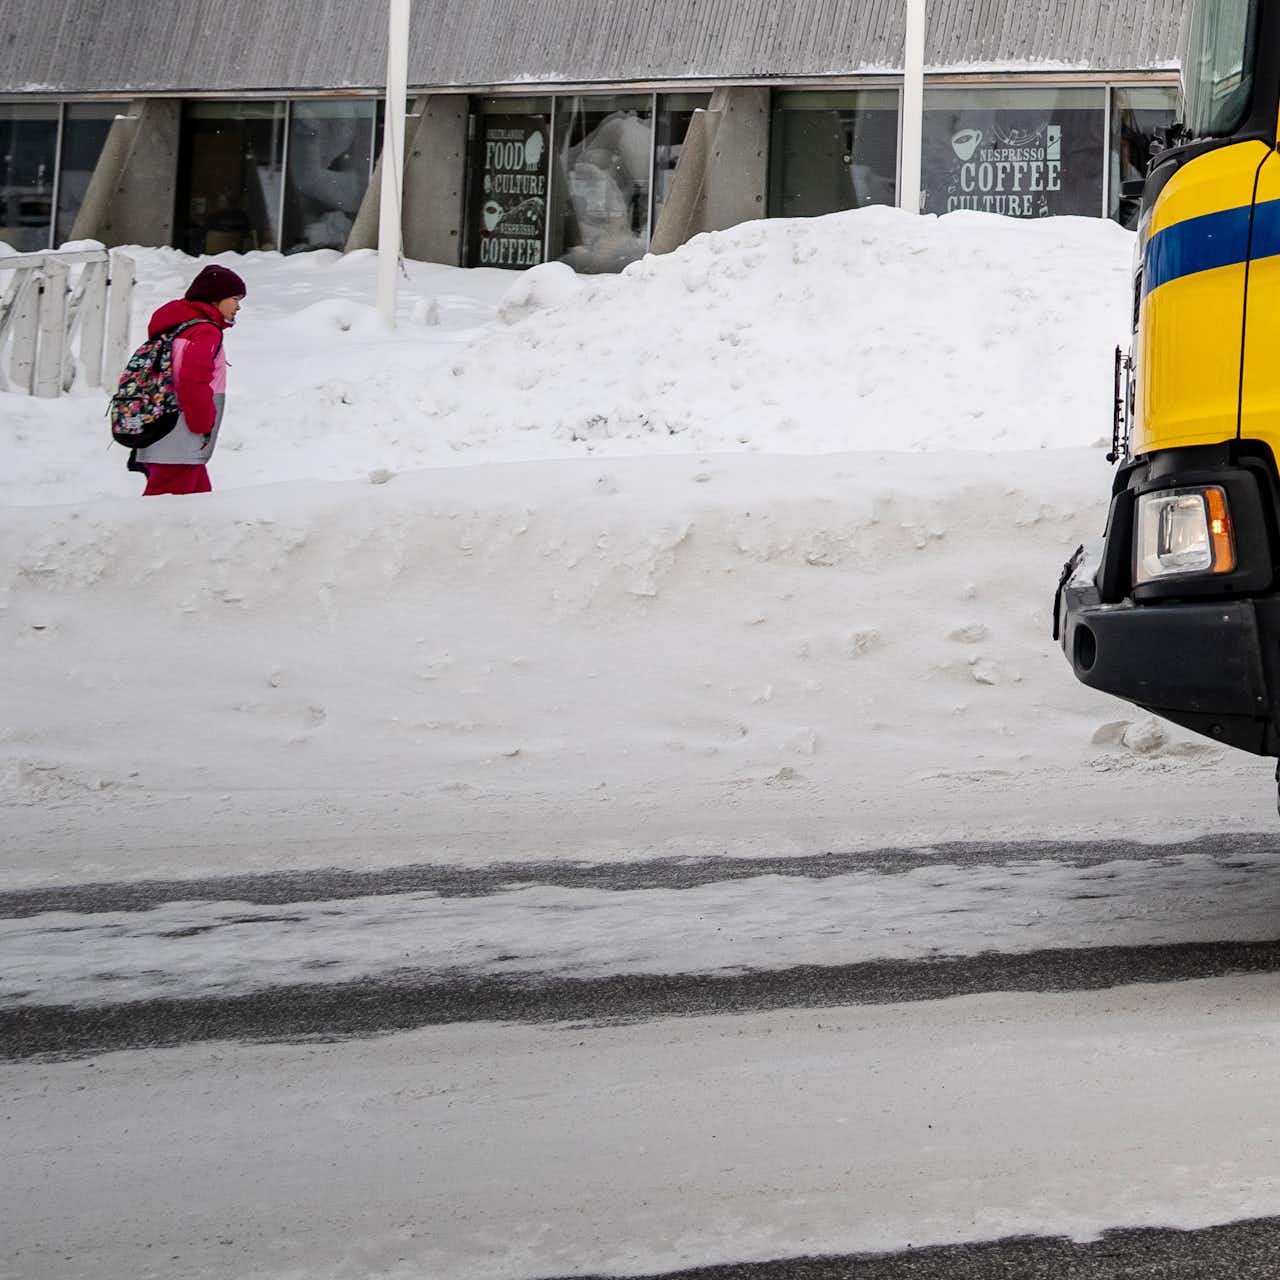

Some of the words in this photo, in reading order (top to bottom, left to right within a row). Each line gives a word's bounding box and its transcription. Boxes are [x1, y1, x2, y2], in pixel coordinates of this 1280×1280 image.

[485, 142, 524, 170] FOOD
[980, 148, 1044, 161] NESPRESSO
[495, 174, 545, 195] CULTURE
[961, 161, 1061, 192] COFFEE
[480, 238, 537, 264] COFFEE
